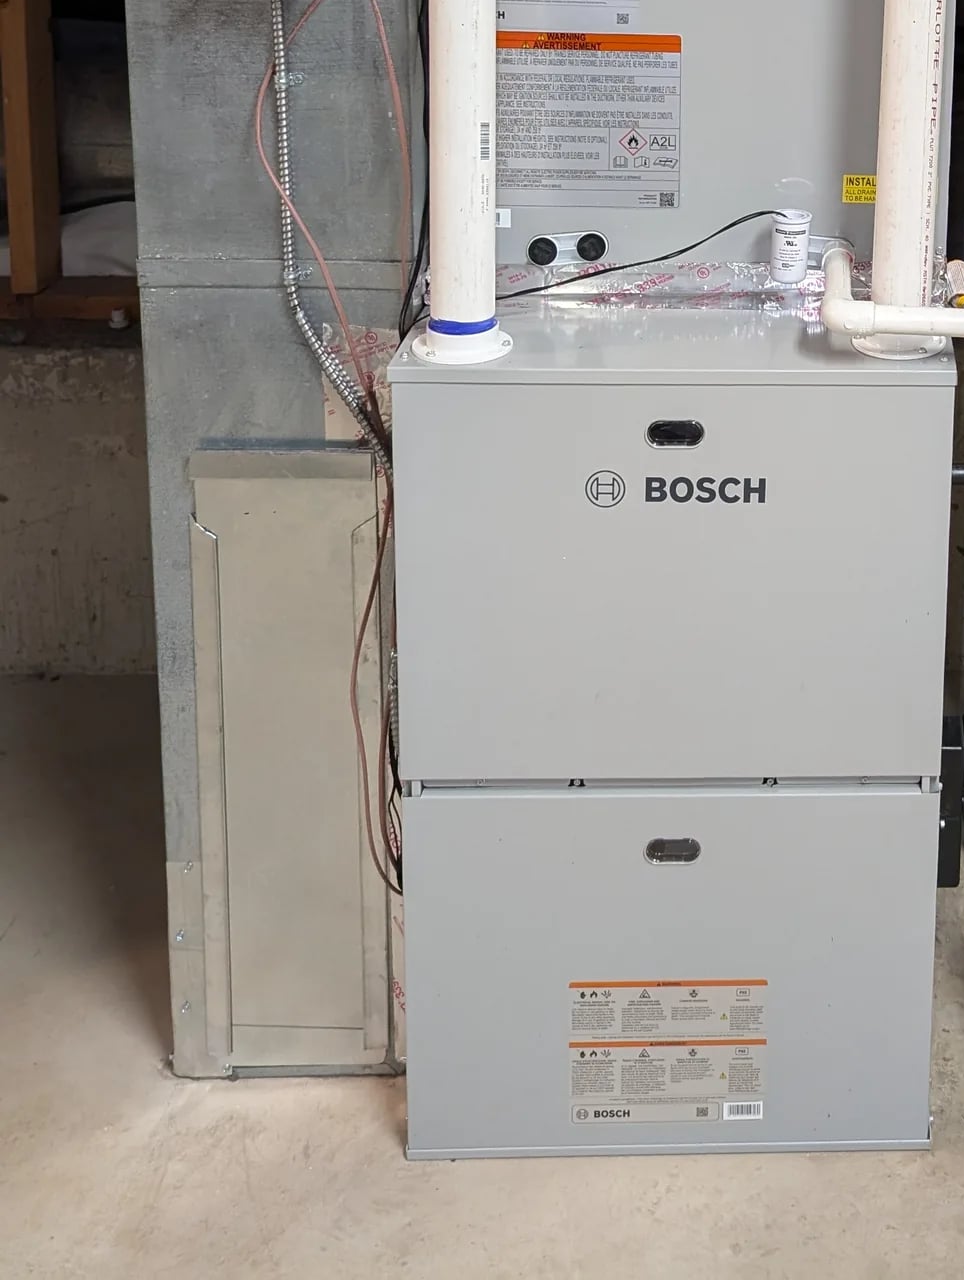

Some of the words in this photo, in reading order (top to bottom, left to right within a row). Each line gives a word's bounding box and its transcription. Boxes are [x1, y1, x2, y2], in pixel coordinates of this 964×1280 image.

[546, 33, 586, 41] WARNING
[533, 42, 601, 50] AVERTISSEMENT
[928, 83, 939, 130] PIPE
[650, 136, 675, 148] A2L
[846, 177, 876, 186] INSTAL
[645, 477, 766, 503] BOSCH
[594, 1109, 630, 1118] BOSCH
